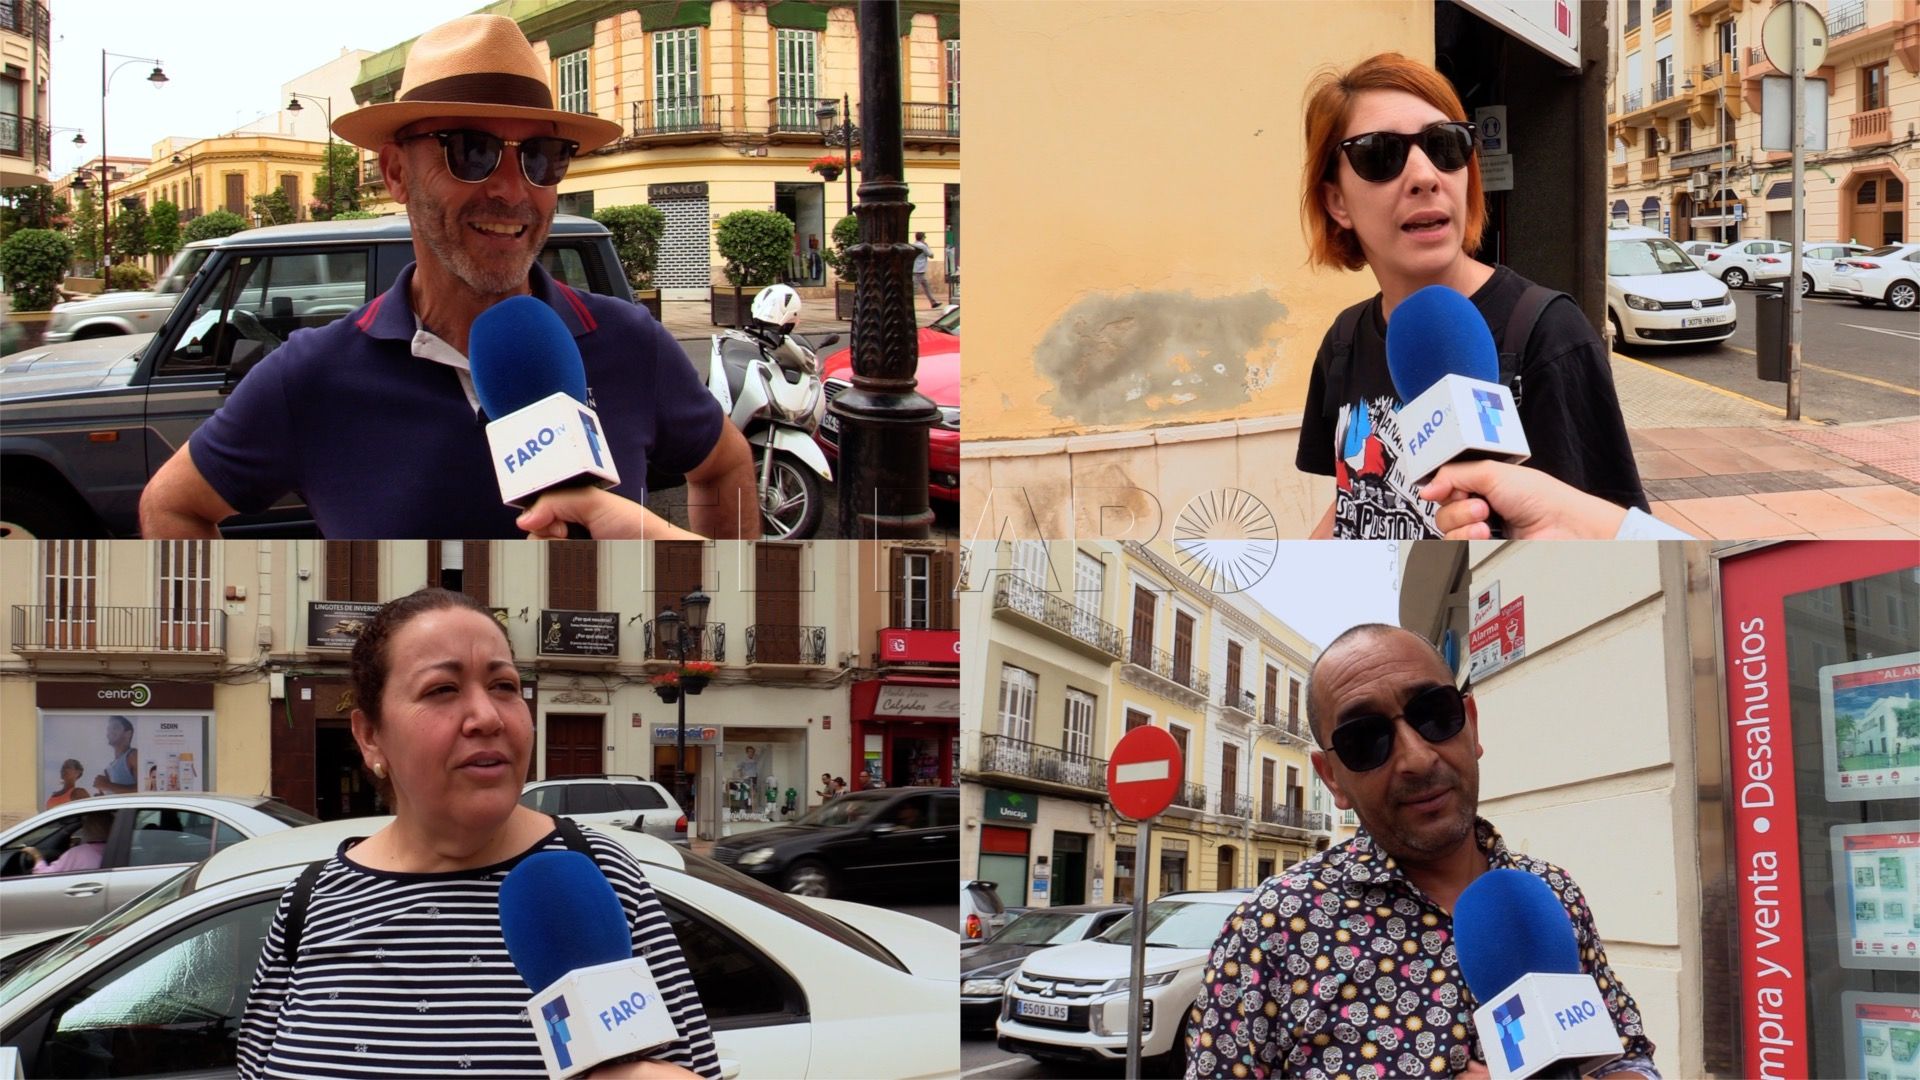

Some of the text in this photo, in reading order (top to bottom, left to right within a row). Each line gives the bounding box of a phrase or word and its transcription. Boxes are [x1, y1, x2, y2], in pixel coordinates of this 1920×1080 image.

[1408, 409, 1444, 456] FARO
[504, 427, 555, 474] FARO
[314, 603, 344, 611] LINGOTES
[1471, 622, 1499, 645] Alarma
[97, 688, 145, 700] centro
[1734, 617, 1775, 809] Desahucios
[1000, 807, 1027, 819] Unicaja
[1747, 851, 1781, 949] venta
[1756, 956, 1792, 979] y
[599, 991, 646, 1032] FARO
[1023, 1003, 1066, 1018] 6509 LRS
[1554, 1000, 1596, 1031] FARO
